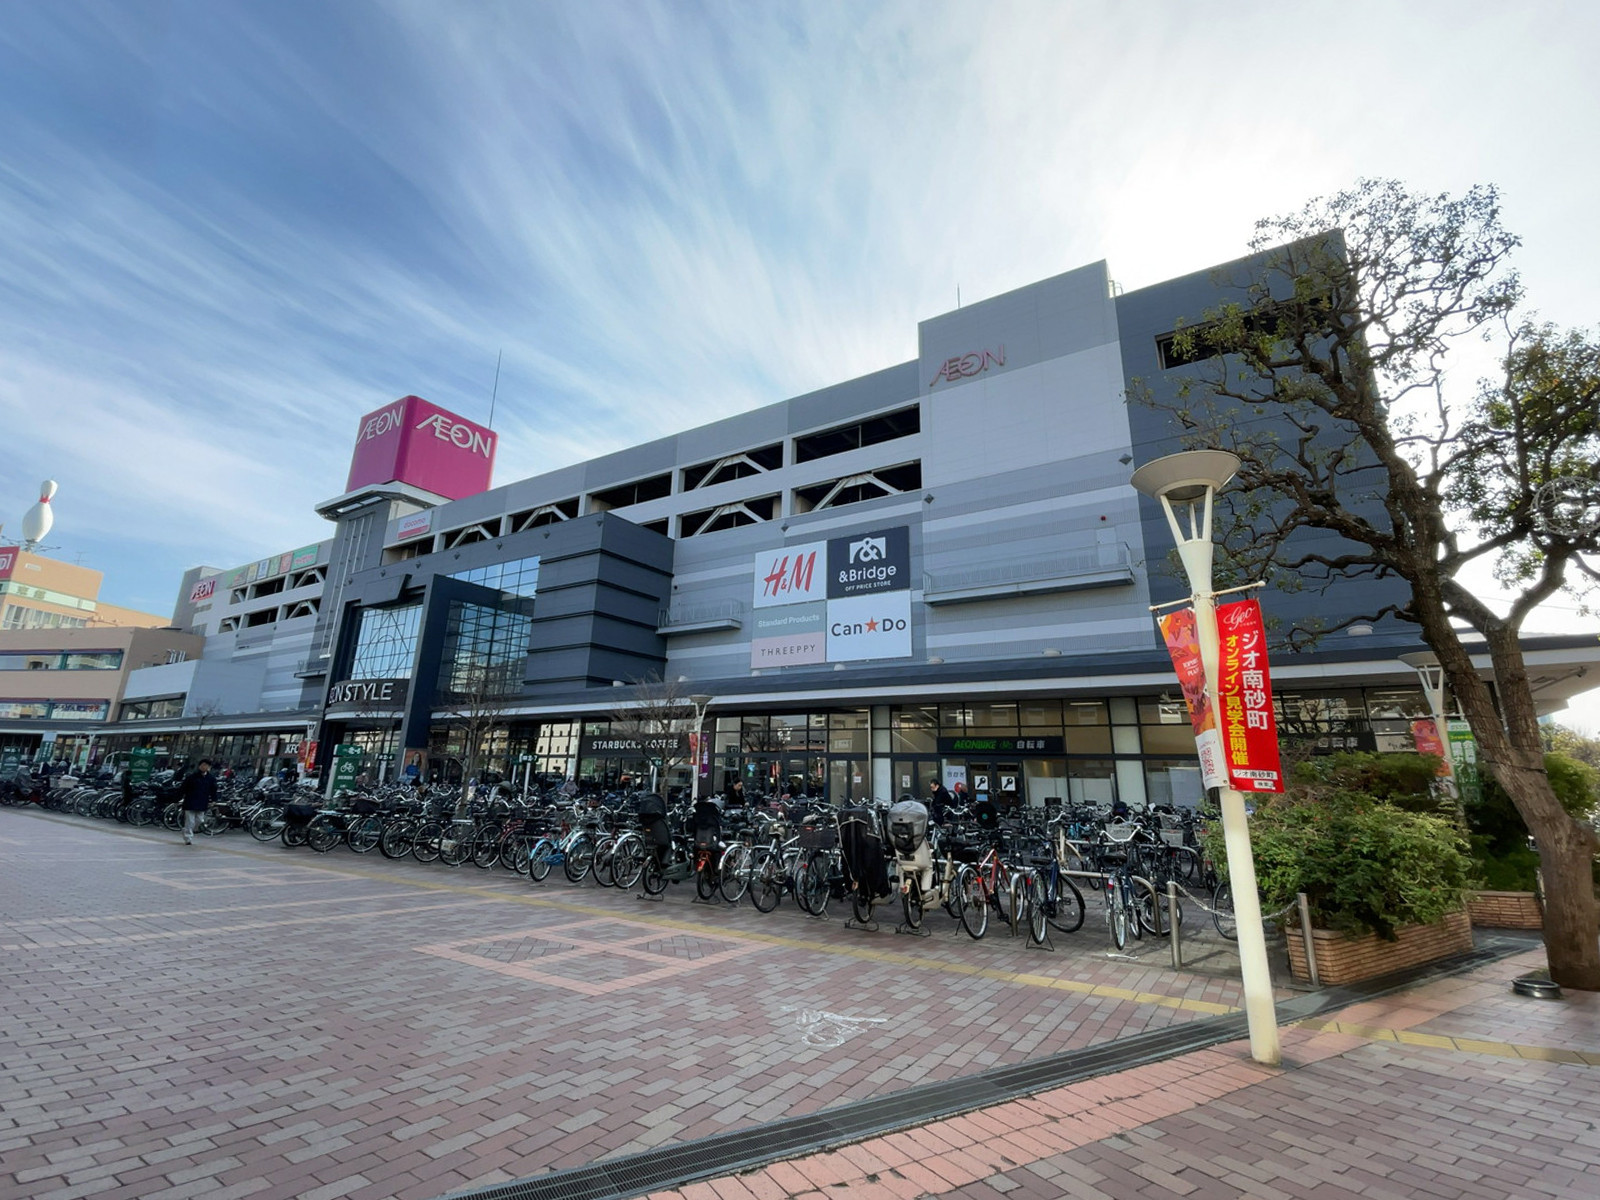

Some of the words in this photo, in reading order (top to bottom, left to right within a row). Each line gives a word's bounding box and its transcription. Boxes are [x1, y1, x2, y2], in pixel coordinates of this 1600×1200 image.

[763, 550, 817, 597] H&M
[838, 563, 897, 584] &Bridge
[856, 582, 872, 590] PRICE
[873, 580, 891, 589] STORE
[757, 617, 788, 629] Standard
[788, 612, 820, 626] Products
[831, 621, 863, 638] Can
[882, 616, 907, 632] Do
[760, 643, 816, 657] THREEPPY
[1241, 629, 1269, 731] ジオ南砂町
[344, 682, 394, 702] STYLE
[1224, 634, 1249, 766] オンライン見学会開催
[1016, 740, 1046, 750] 自転車
